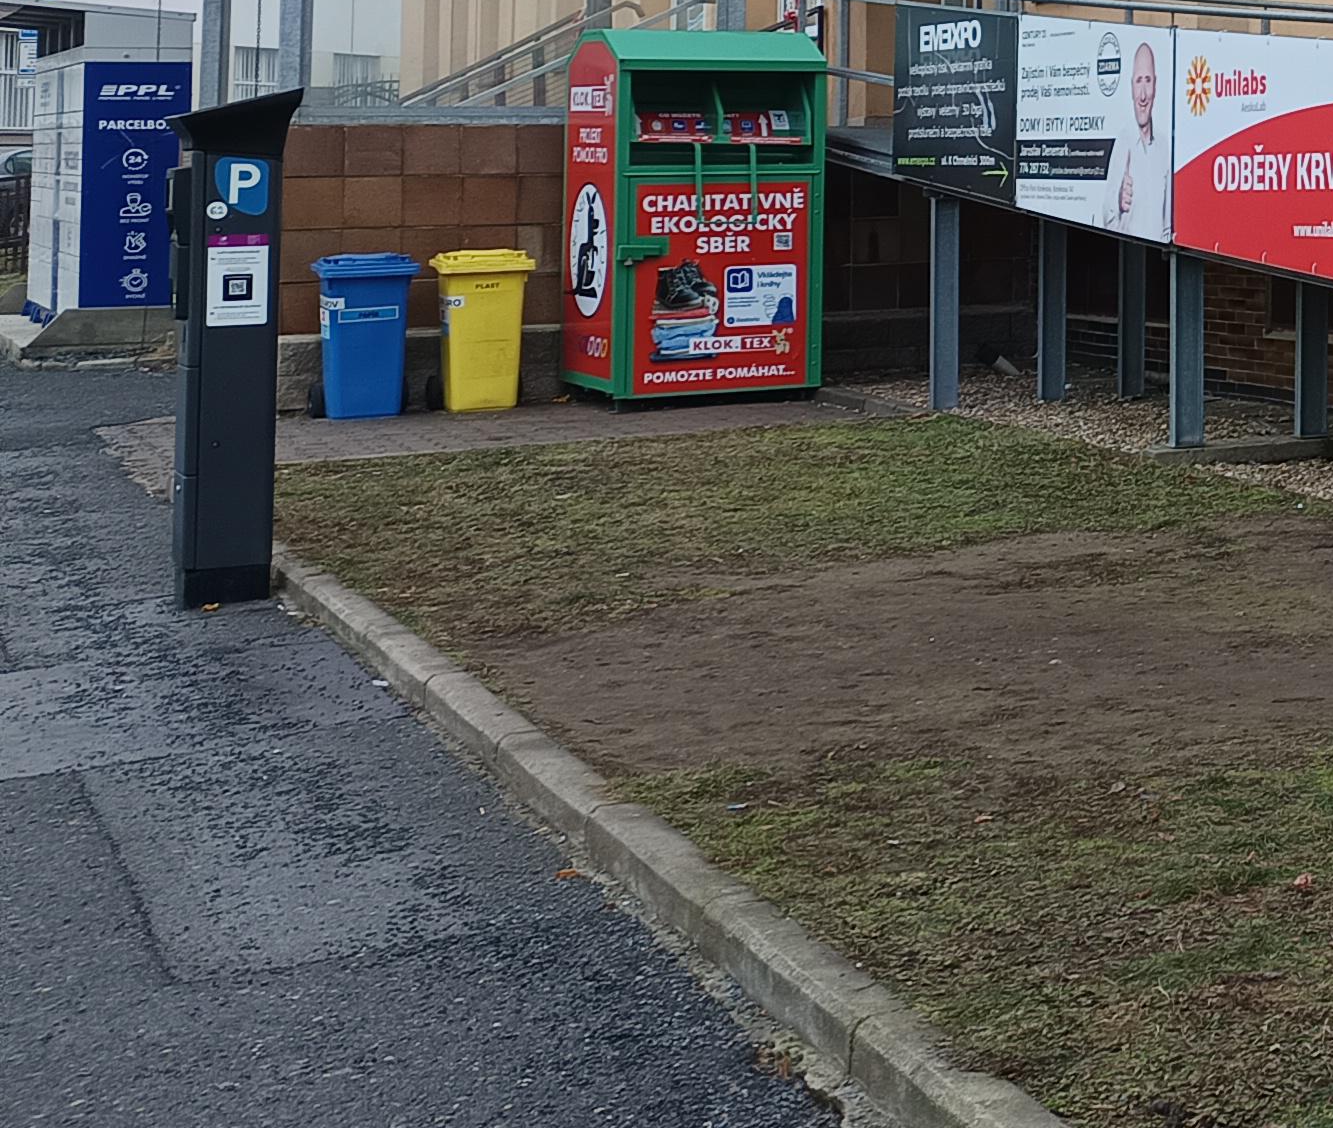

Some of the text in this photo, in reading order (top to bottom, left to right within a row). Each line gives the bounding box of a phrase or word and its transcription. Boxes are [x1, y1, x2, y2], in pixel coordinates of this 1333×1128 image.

[919, 20, 982, 53] EMEXPO
[117, 84, 175, 96] PPL
[1214, 68, 1267, 98] Unilabs
[98, 119, 171, 130] PARCELBO
[1020, 116, 1105, 132] DOMY BYTY POZEMKY
[128, 155, 142, 164] 24
[1213, 144, 1292, 192] ODBĚRY
[228, 163, 261, 204] P
[642, 188, 805, 213] CHAITATVNĚ
[695, 232, 751, 254] SBĚR
[744, 336, 771, 349] TEX
[644, 368, 714, 384] POMOZTE
